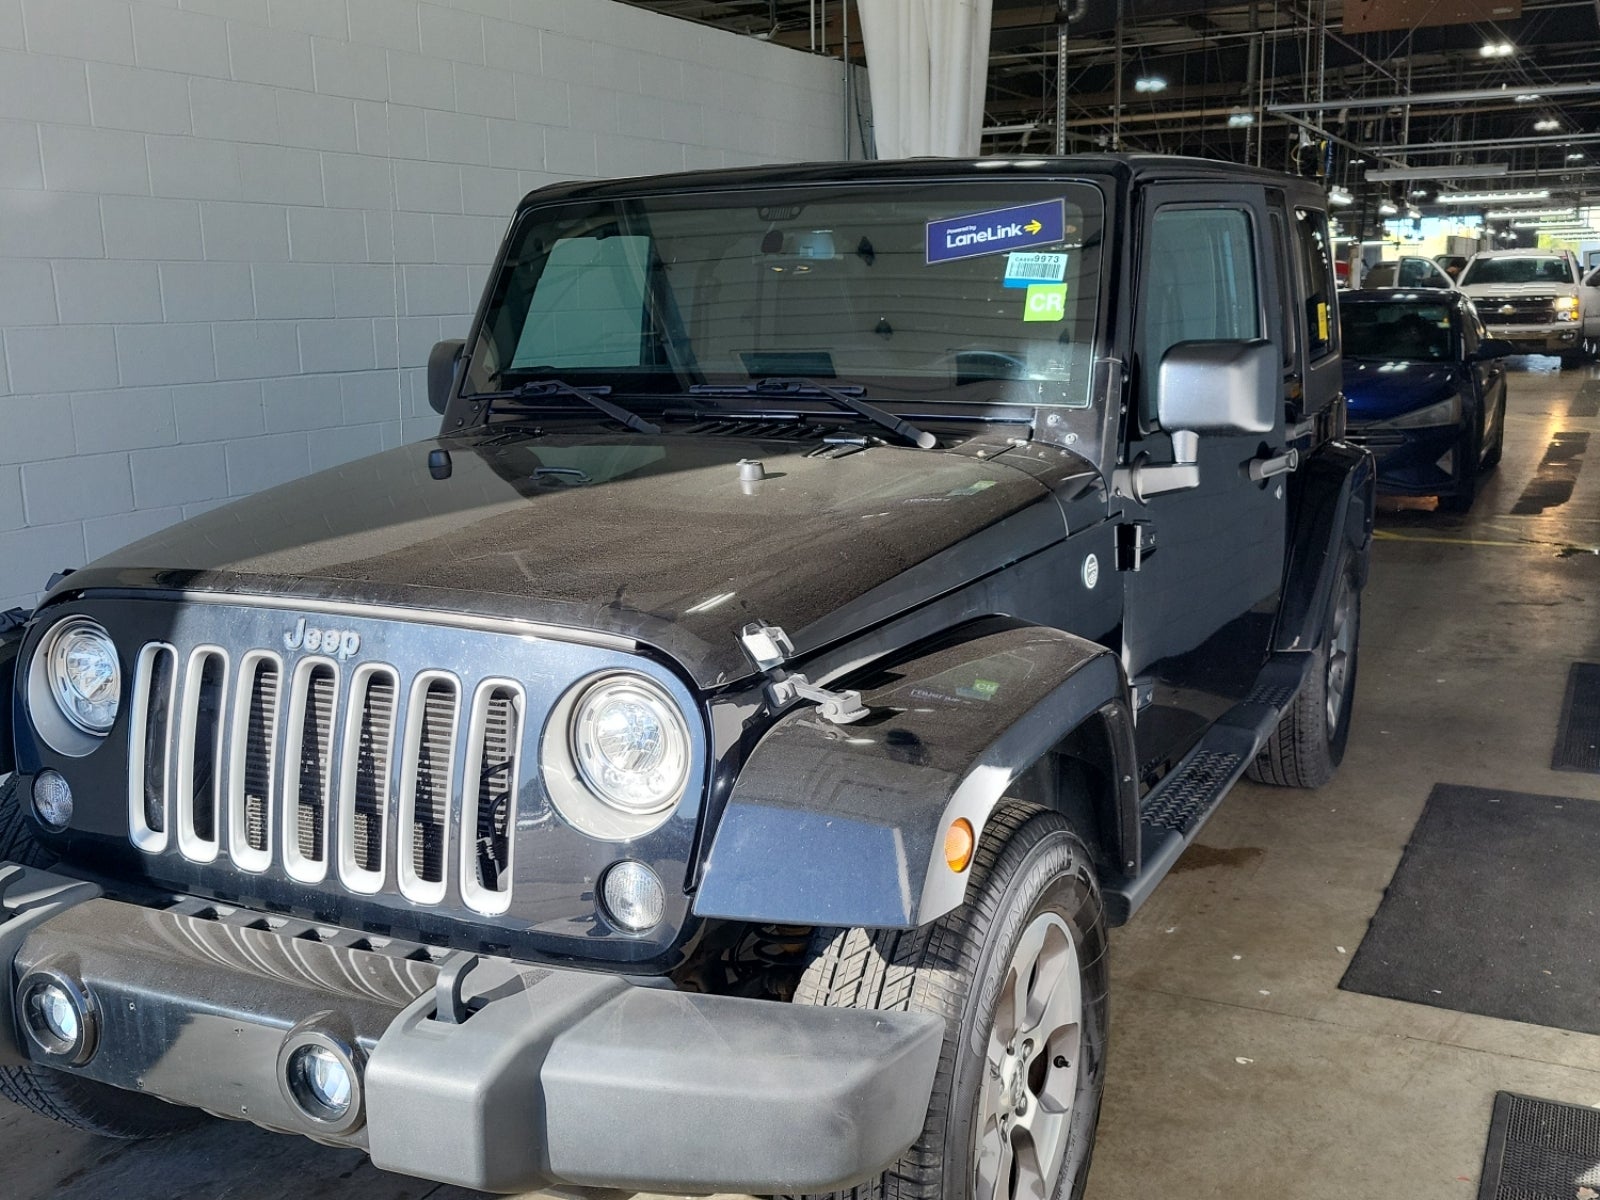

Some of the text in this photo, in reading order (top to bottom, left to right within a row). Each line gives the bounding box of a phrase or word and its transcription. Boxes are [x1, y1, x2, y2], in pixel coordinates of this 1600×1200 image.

[946, 226, 968, 234] Powered
[946, 223, 1023, 248] LaneLink
[1029, 292, 1062, 312] CR
[283, 617, 361, 662] Jeep
